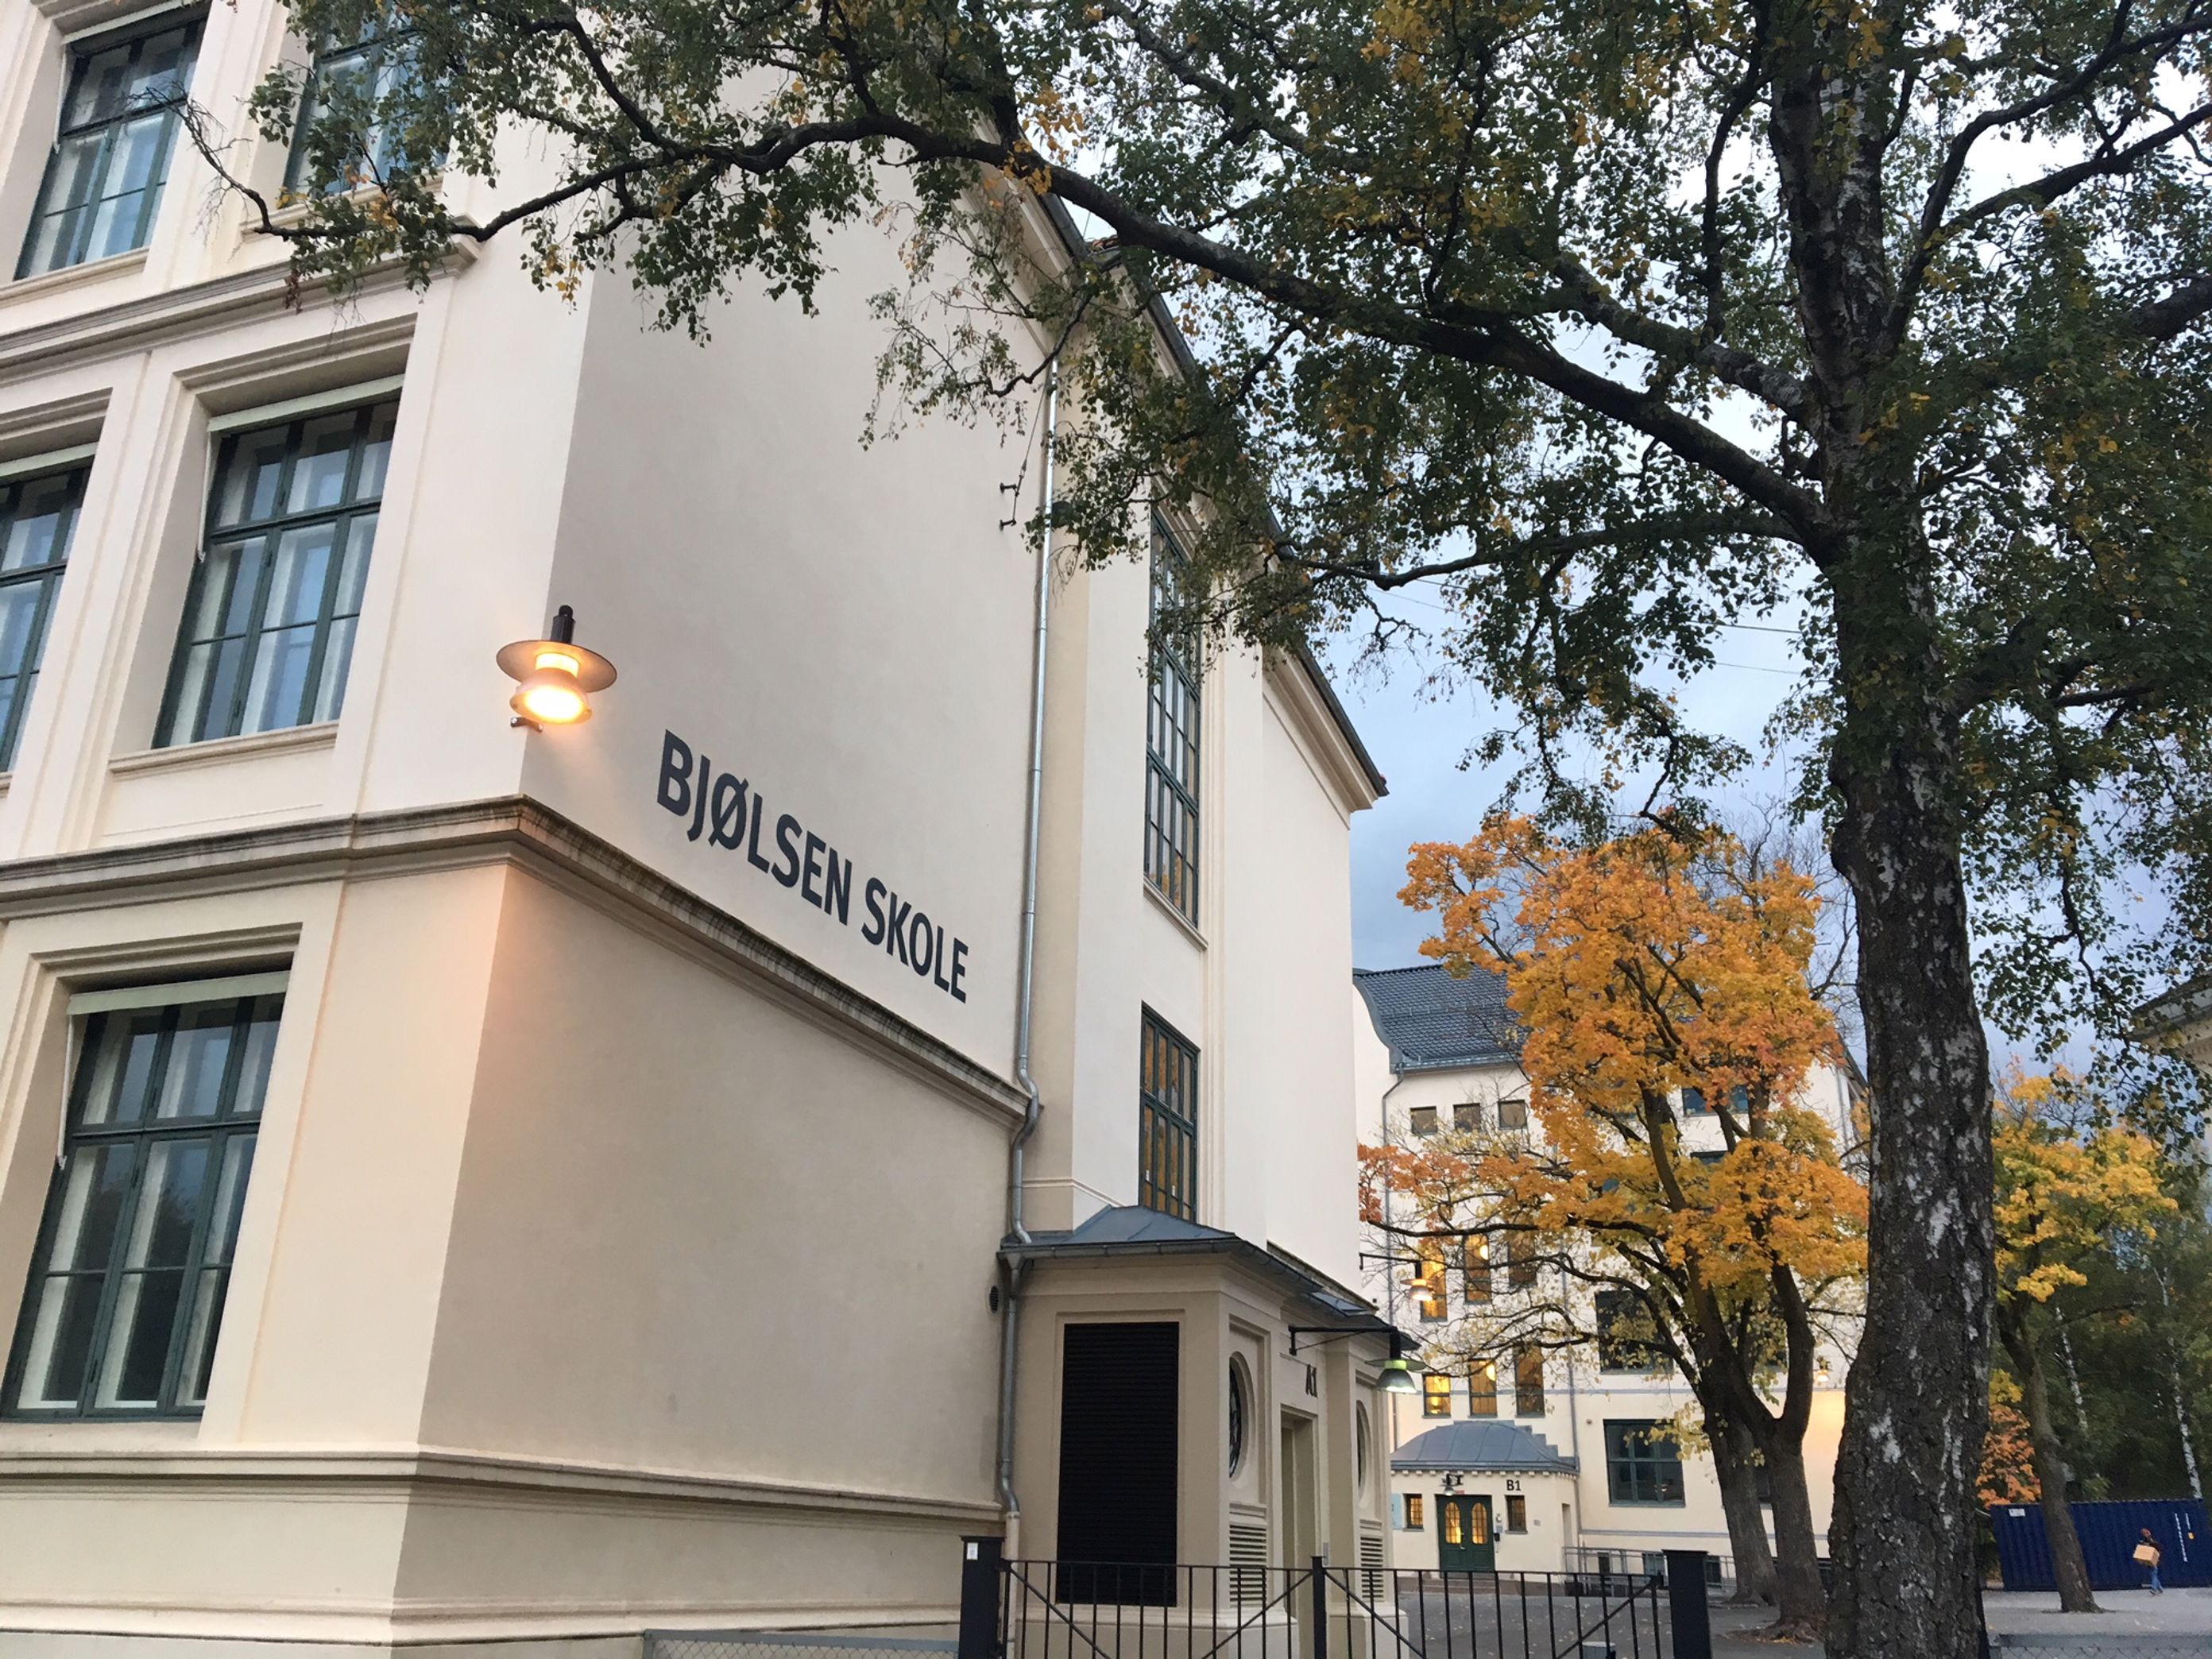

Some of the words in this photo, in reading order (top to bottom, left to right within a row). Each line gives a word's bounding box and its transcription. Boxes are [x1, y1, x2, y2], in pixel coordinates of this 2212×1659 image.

[656, 729, 853, 926] BJØLSEN
[860, 877, 969, 1004] SKOLE
[1305, 1363, 1318, 1398] A1
[1506, 1479, 1522, 1491] B1
